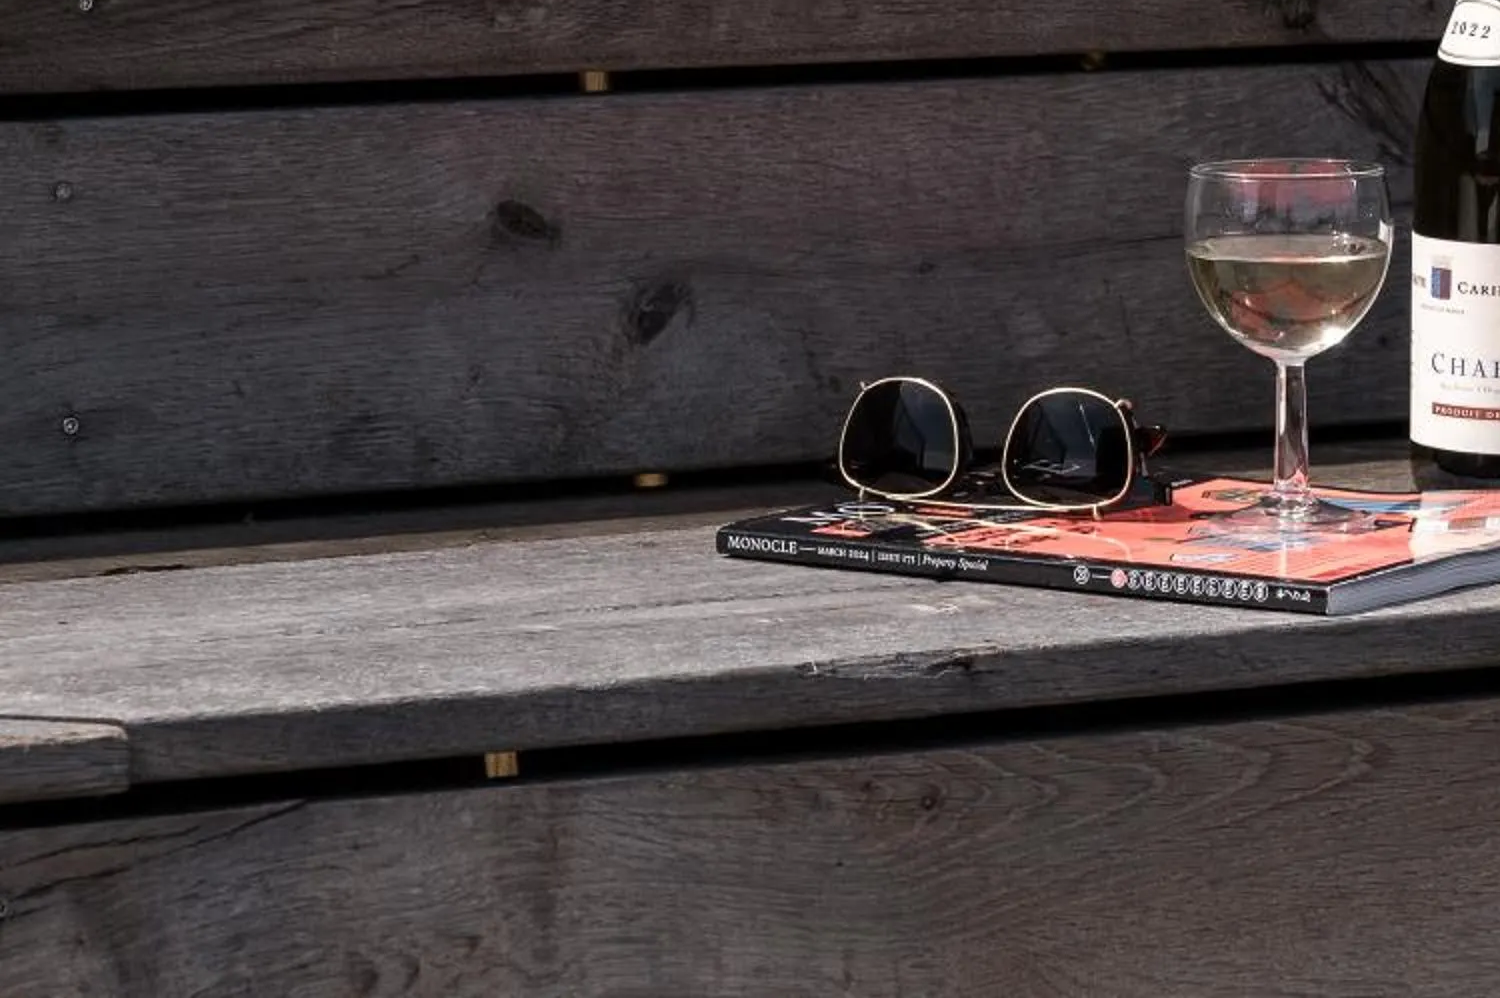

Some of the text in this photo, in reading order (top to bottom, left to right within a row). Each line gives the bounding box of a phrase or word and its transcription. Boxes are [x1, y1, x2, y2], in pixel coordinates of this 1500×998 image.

[1451, 20, 1492, 39] 2022
[1435, 405, 1479, 419] PRODUIT
[727, 535, 798, 555] MONOCLE
[817, 546, 847, 557] MARCH
[922, 553, 956, 570] Property
[957, 557, 989, 571] Special
